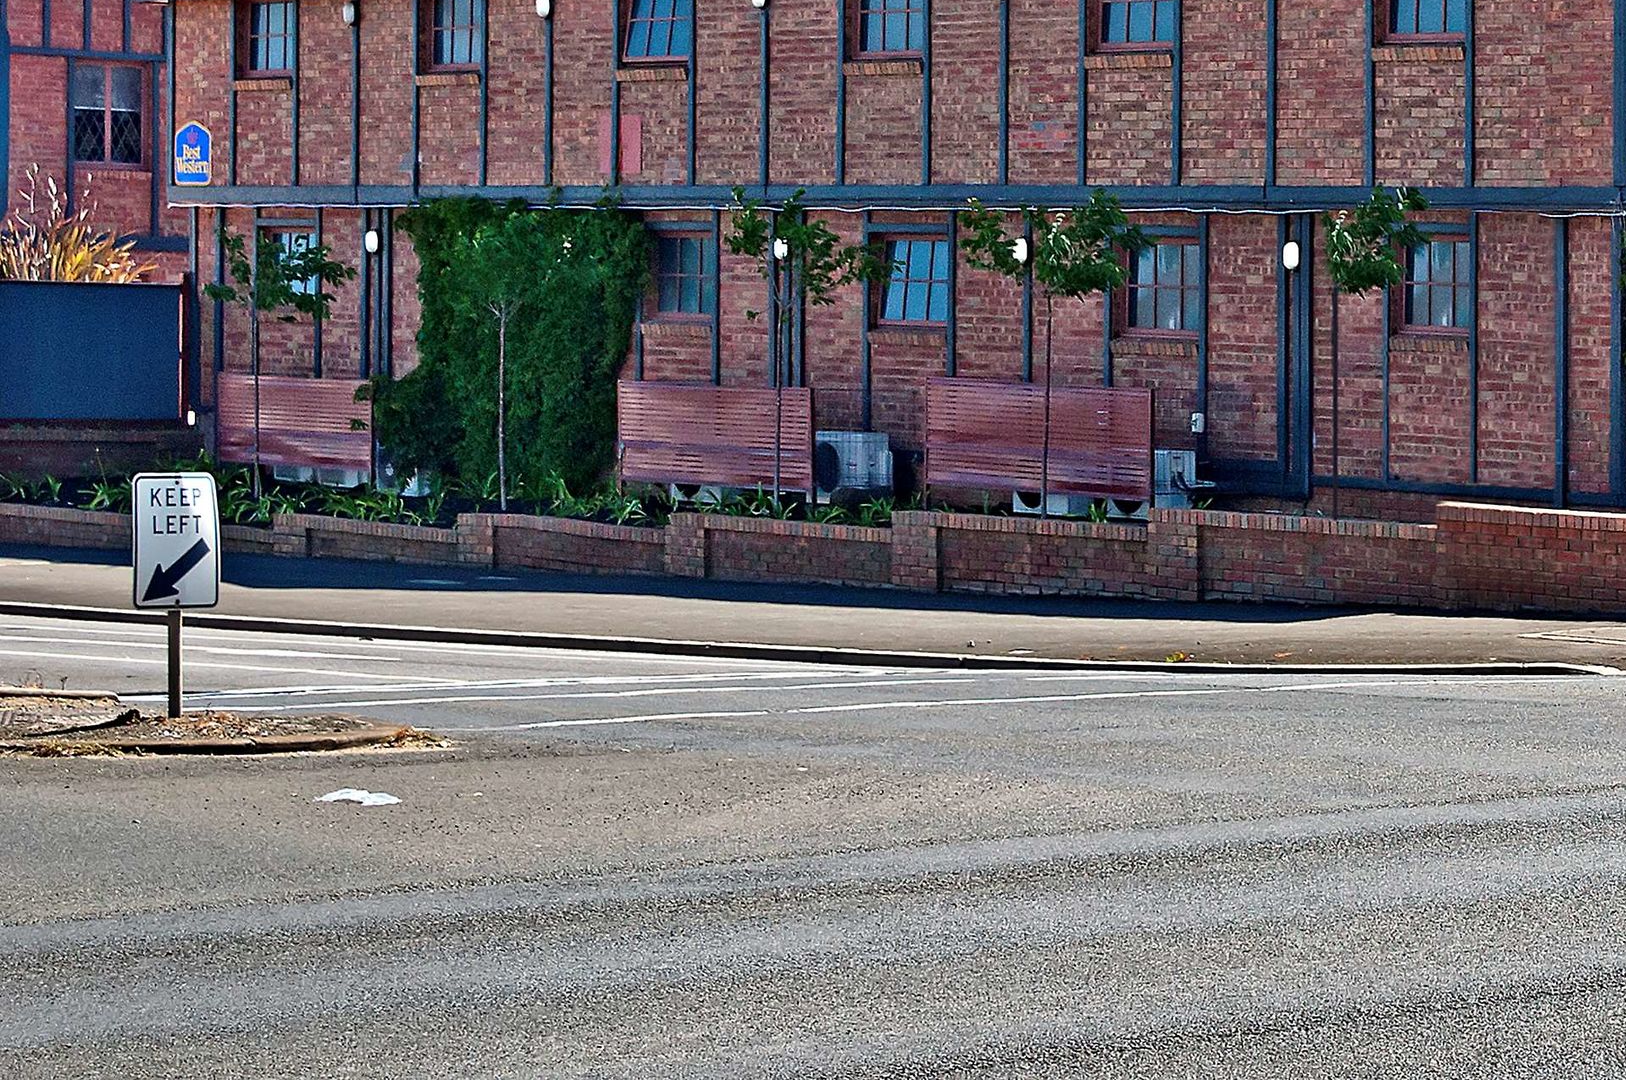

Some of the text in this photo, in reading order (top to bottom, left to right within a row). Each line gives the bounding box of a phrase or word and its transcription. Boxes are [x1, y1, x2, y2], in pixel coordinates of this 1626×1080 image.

[182, 144, 201, 159] Best
[150, 488, 201, 507] KEEP
[152, 515, 202, 534] LEFT
